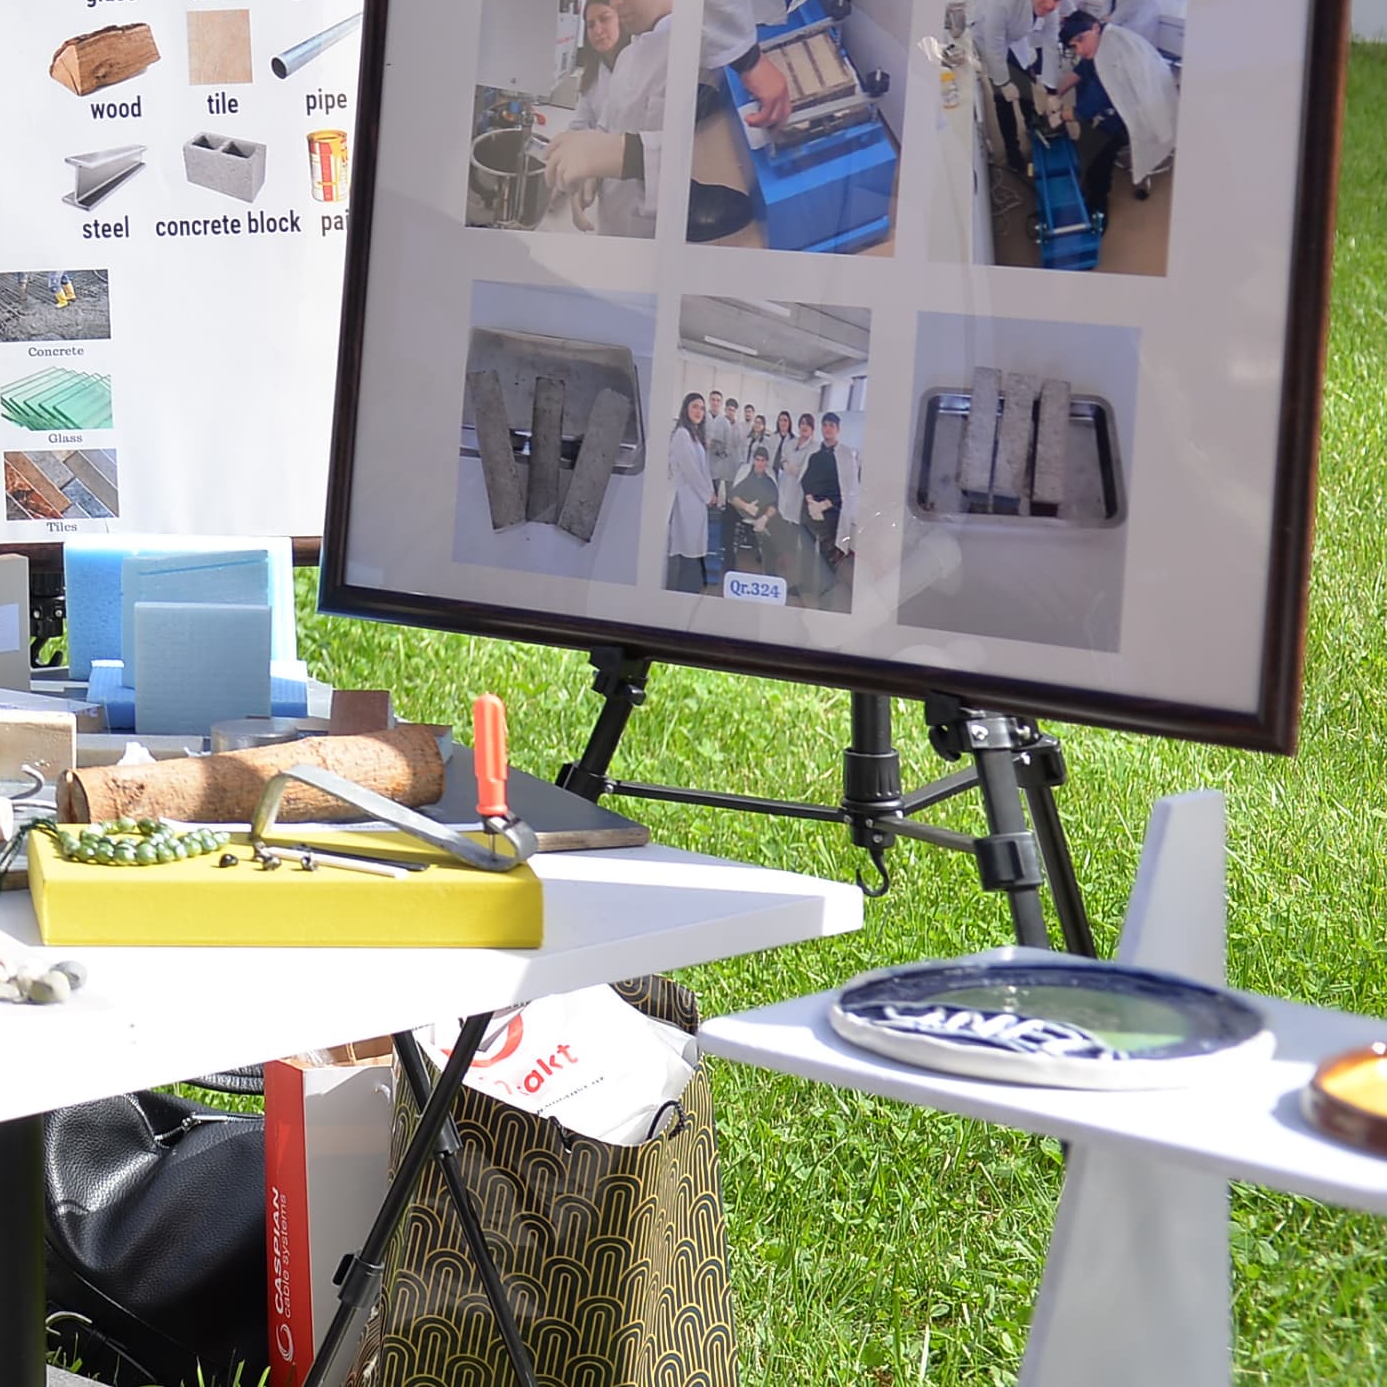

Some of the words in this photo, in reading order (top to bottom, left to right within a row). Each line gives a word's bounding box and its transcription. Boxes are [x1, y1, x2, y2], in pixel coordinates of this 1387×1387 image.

[90, 95, 142, 119] wood
[207, 92, 239, 115] tile
[306, 88, 348, 116] pipe
[82, 215, 130, 239] steel
[155, 214, 241, 236] concrete
[247, 209, 302, 234] block
[28, 346, 84, 358] Concrete
[48, 433, 83, 445] Glass
[46, 522, 78, 533] Tiles
[729, 580, 780, 598] Qr.324
[280, 1194, 290, 1264] systems
[272, 1187, 283, 1314] CASPIAN
[280, 1271, 291, 1318] cable
